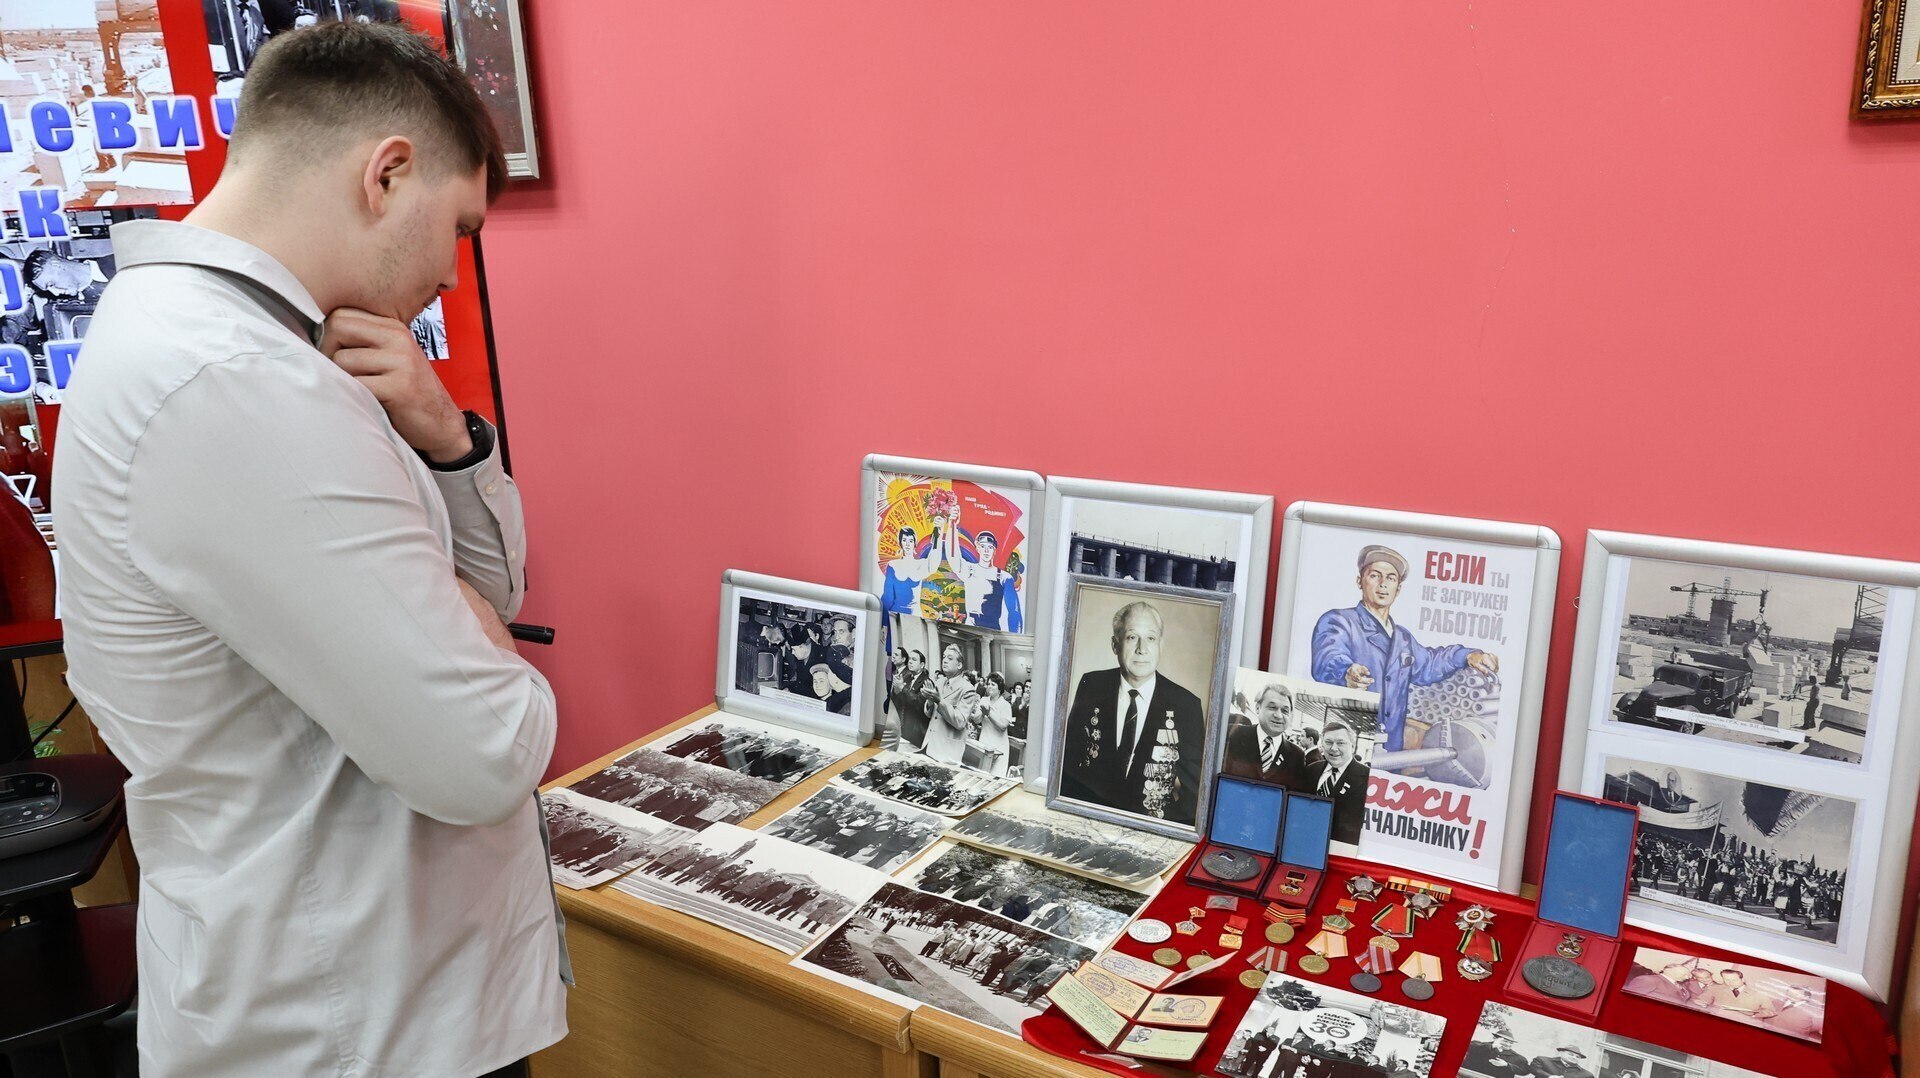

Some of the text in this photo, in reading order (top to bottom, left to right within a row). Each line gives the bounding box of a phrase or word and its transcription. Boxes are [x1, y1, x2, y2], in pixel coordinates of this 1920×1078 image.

[1425, 551, 1510, 588] ЕСЛИ ТЫ
[1422, 585, 1508, 611] НЕ ЗАГРУЖЕН
[1419, 607, 1507, 645] РАБОТОЙ,
[1365, 776, 1472, 825] ажи
[1309, 1021, 1350, 1039] 30
